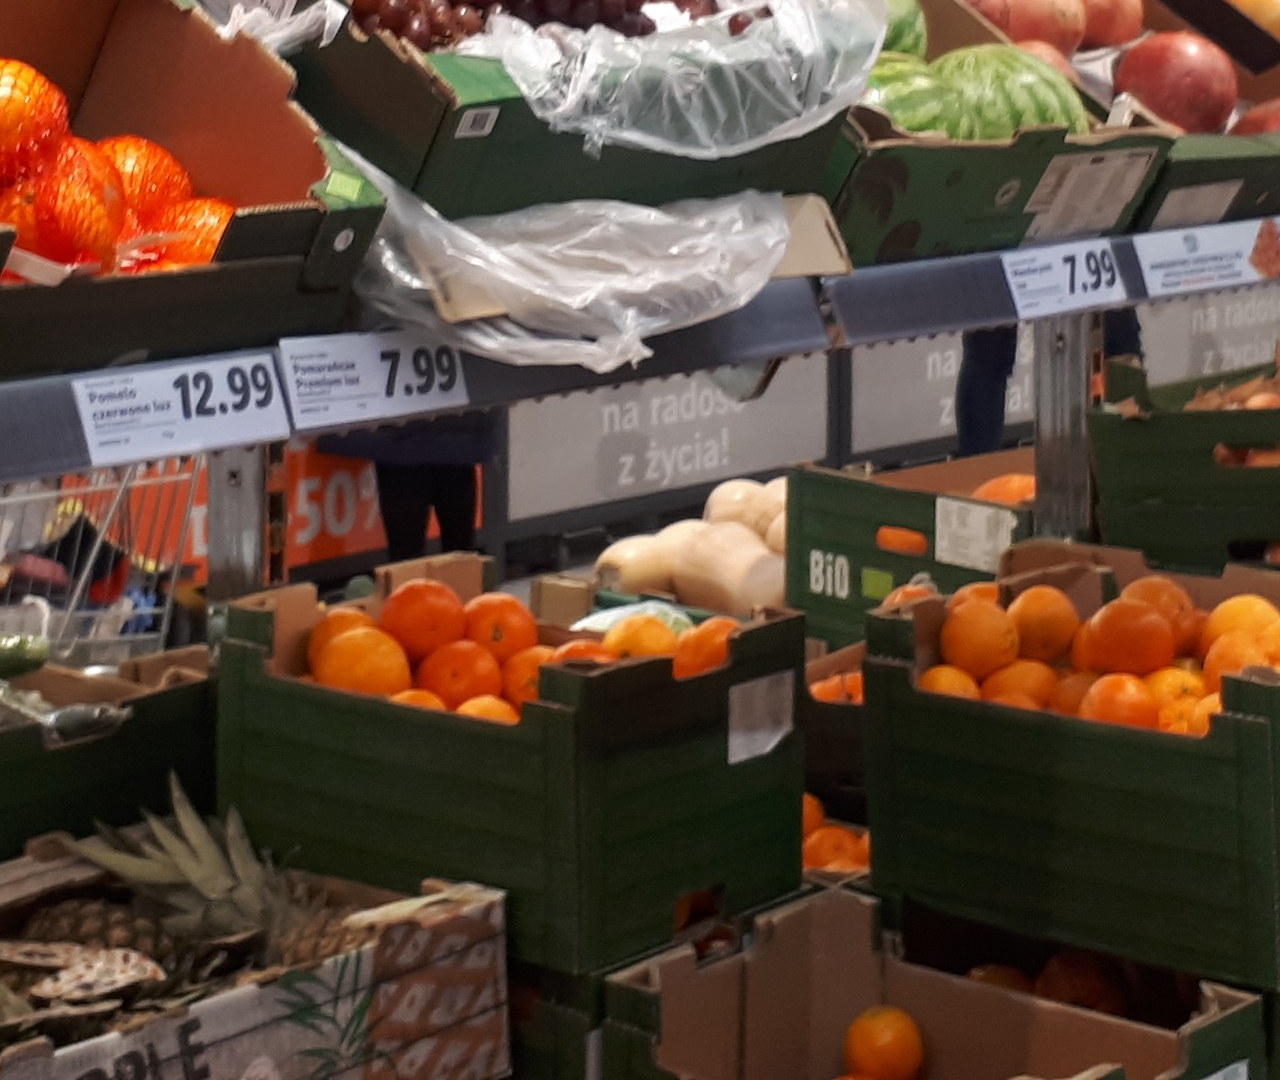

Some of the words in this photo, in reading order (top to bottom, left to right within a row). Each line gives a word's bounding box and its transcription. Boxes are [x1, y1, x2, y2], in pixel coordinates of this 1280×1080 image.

[1062, 247, 1117, 296] 7.99
[379, 344, 458, 398] 7.99
[927, 349, 956, 380] na
[172, 362, 275, 421] 12.99
[602, 400, 640, 433] na
[649, 380, 746, 426] radoś
[618, 453, 636, 486] z
[644, 427, 731, 488] życia!
